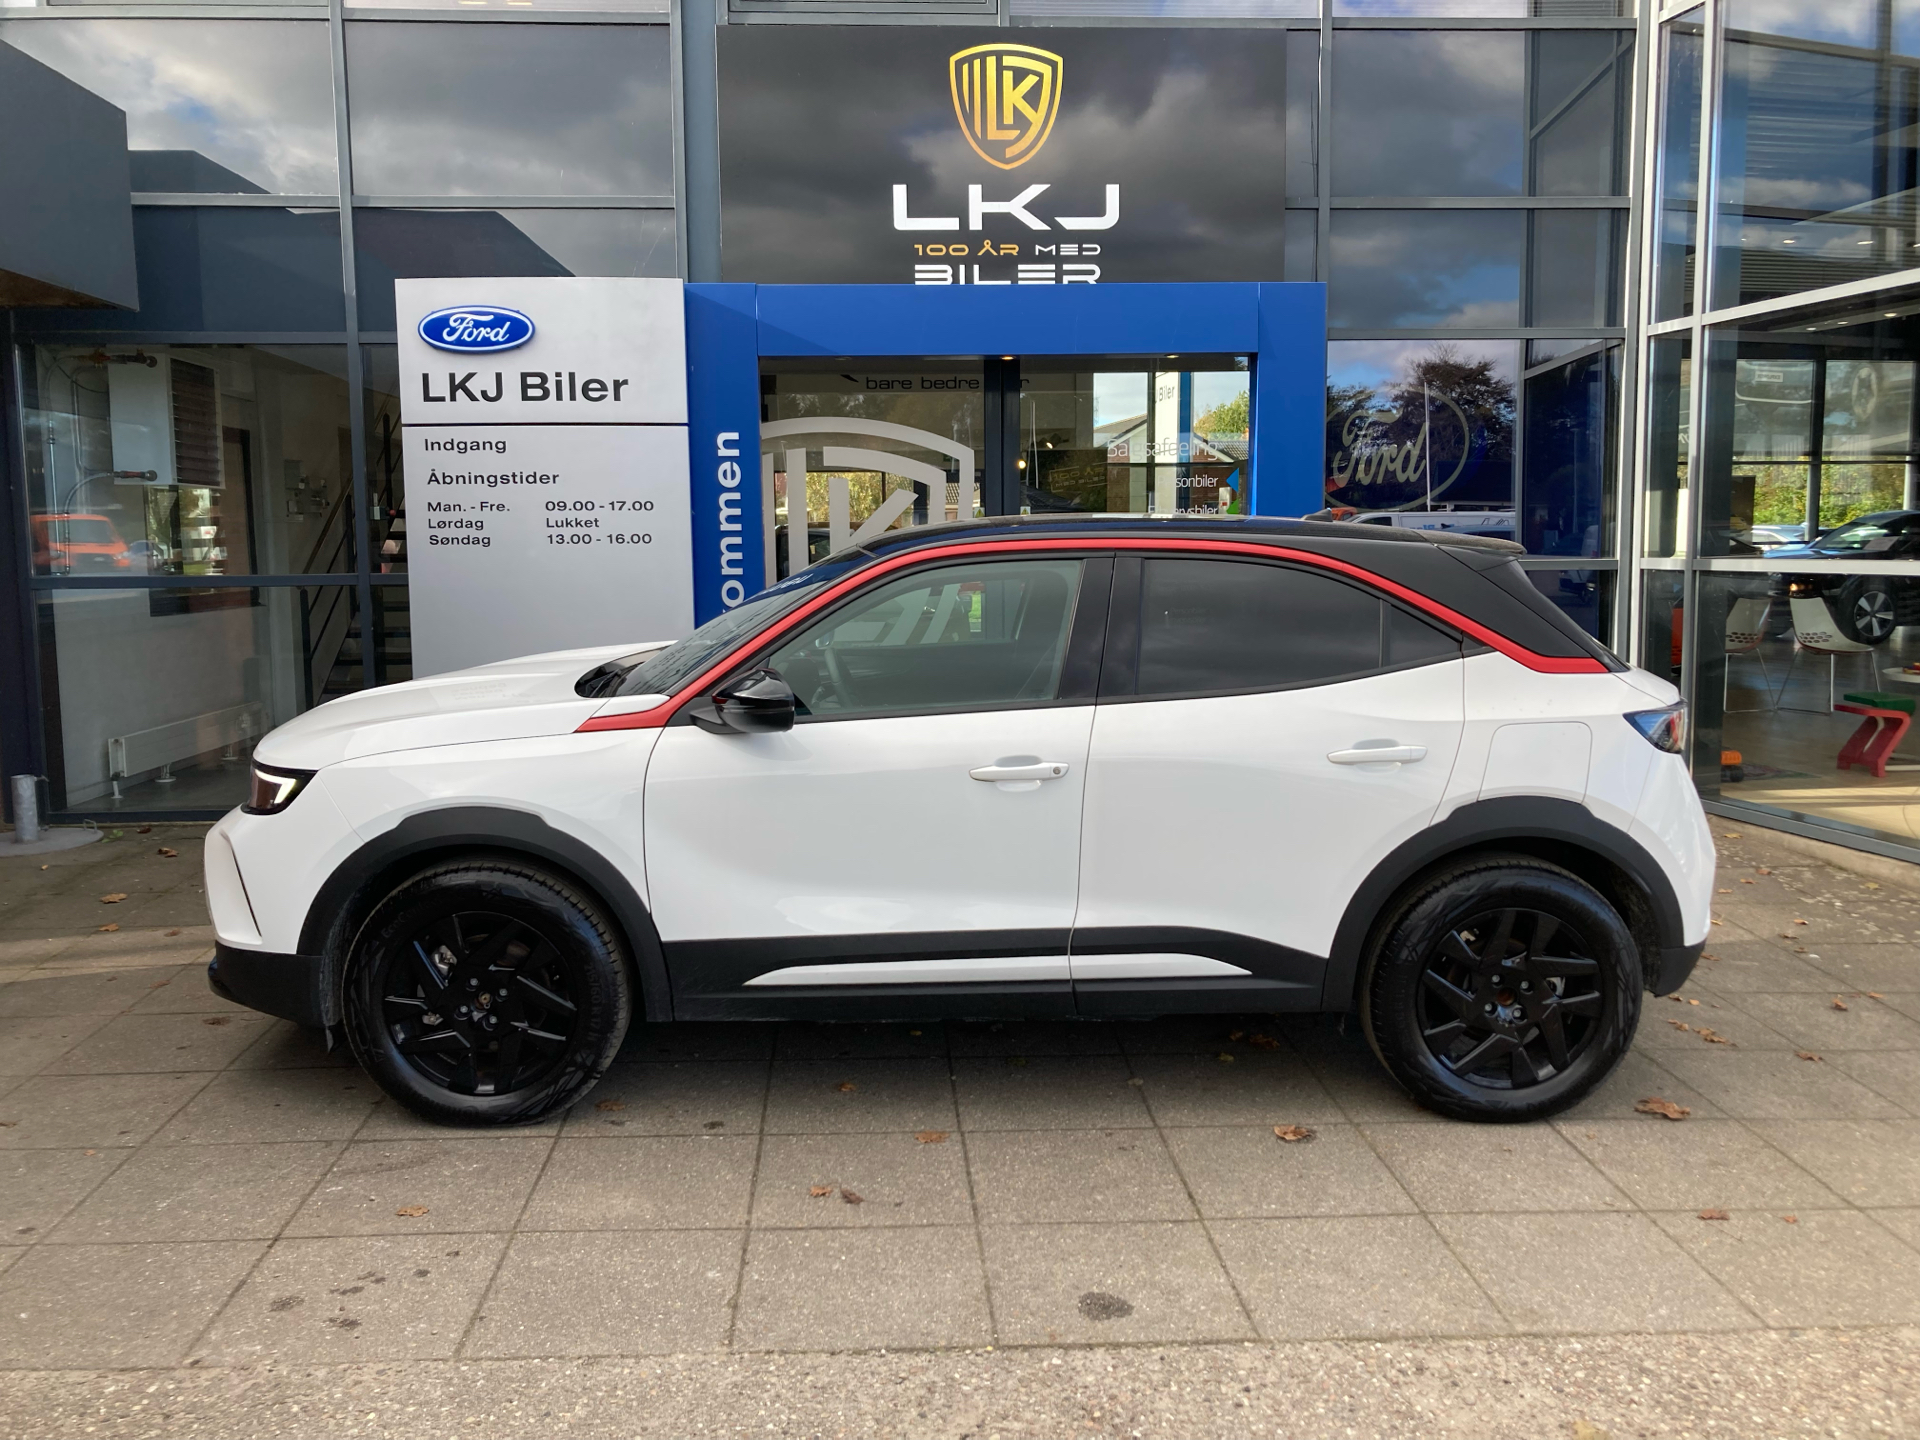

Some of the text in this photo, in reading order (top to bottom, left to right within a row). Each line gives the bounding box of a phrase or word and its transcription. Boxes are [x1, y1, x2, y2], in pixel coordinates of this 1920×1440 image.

[892, 184, 1120, 231] LKJ
[914, 239, 1101, 256] 100 ÅR MED
[914, 264, 1101, 285] BILER
[442, 312, 511, 342] Ford
[422, 371, 629, 403] LKJ Biler
[866, 376, 979, 390] bare bedre
[424, 438, 507, 454] Indgang
[1332, 408, 1430, 488] Ford
[427, 468, 560, 488] Åbningstider
[427, 501, 467, 512] Man.
[480, 501, 510, 512] Fre.
[545, 500, 595, 512] 09.00
[609, 500, 654, 512] 17.00
[428, 517, 600, 531] Lørdag Lukket
[716, 431, 745, 612] ommen
[429, 534, 491, 548] Søndag
[547, 533, 592, 545] 13.00
[607, 533, 652, 545] 16.00
